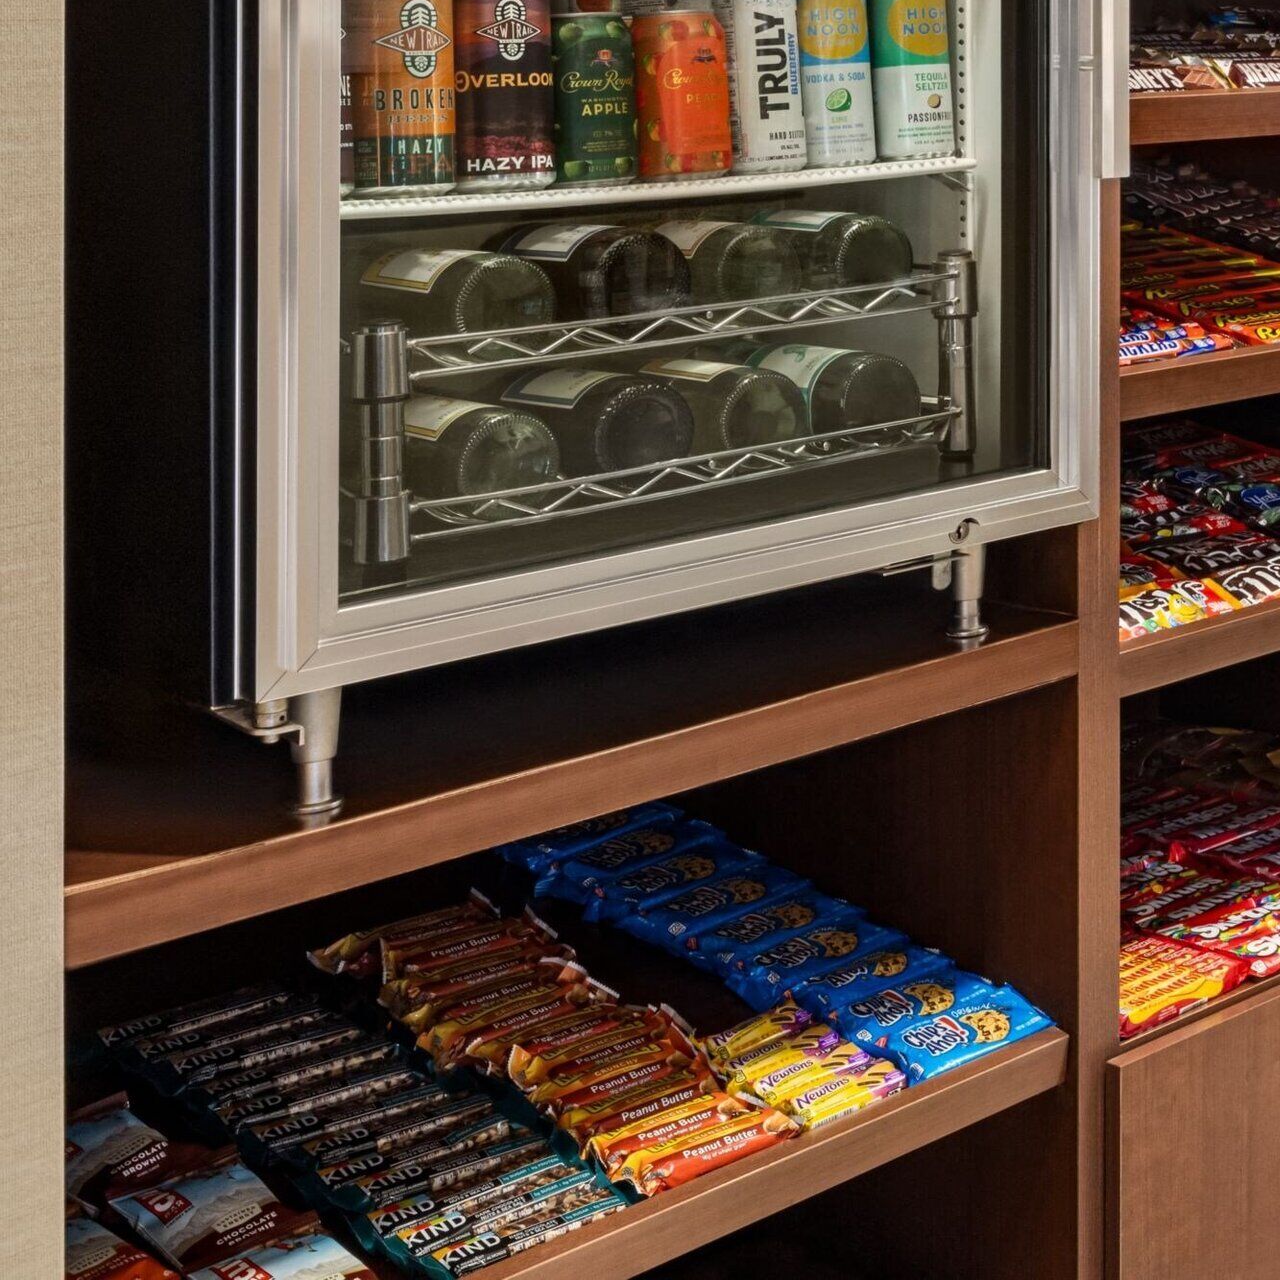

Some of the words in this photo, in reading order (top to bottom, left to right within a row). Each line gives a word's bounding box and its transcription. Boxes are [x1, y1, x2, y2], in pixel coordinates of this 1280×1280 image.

[809, 6, 857, 21] HIGH
[486, 24, 508, 39] NEW
[511, 24, 535, 38] TRAIL
[806, 24, 860, 36] NOON
[752, 10, 790, 120] TRULY
[581, 102, 629, 117] APPLE
[397, 138, 444, 155] HAZY
[466, 155, 526, 173] HAZY
[903, 1021, 945, 1049] Chips
[760, 1058, 813, 1089] Newtons
[796, 1075, 850, 1109] Newtons
[638, 1122, 679, 1143] Peanut
[679, 1109, 713, 1130] Butter
[683, 1139, 724, 1161] Peanut
[723, 1127, 758, 1148] Butter
[121, 1150, 168, 1179] BROWNIE
[215, 1210, 279, 1246] CHOCOLATE
[402, 1212, 468, 1250] KIND
[439, 1232, 501, 1271] KIND
